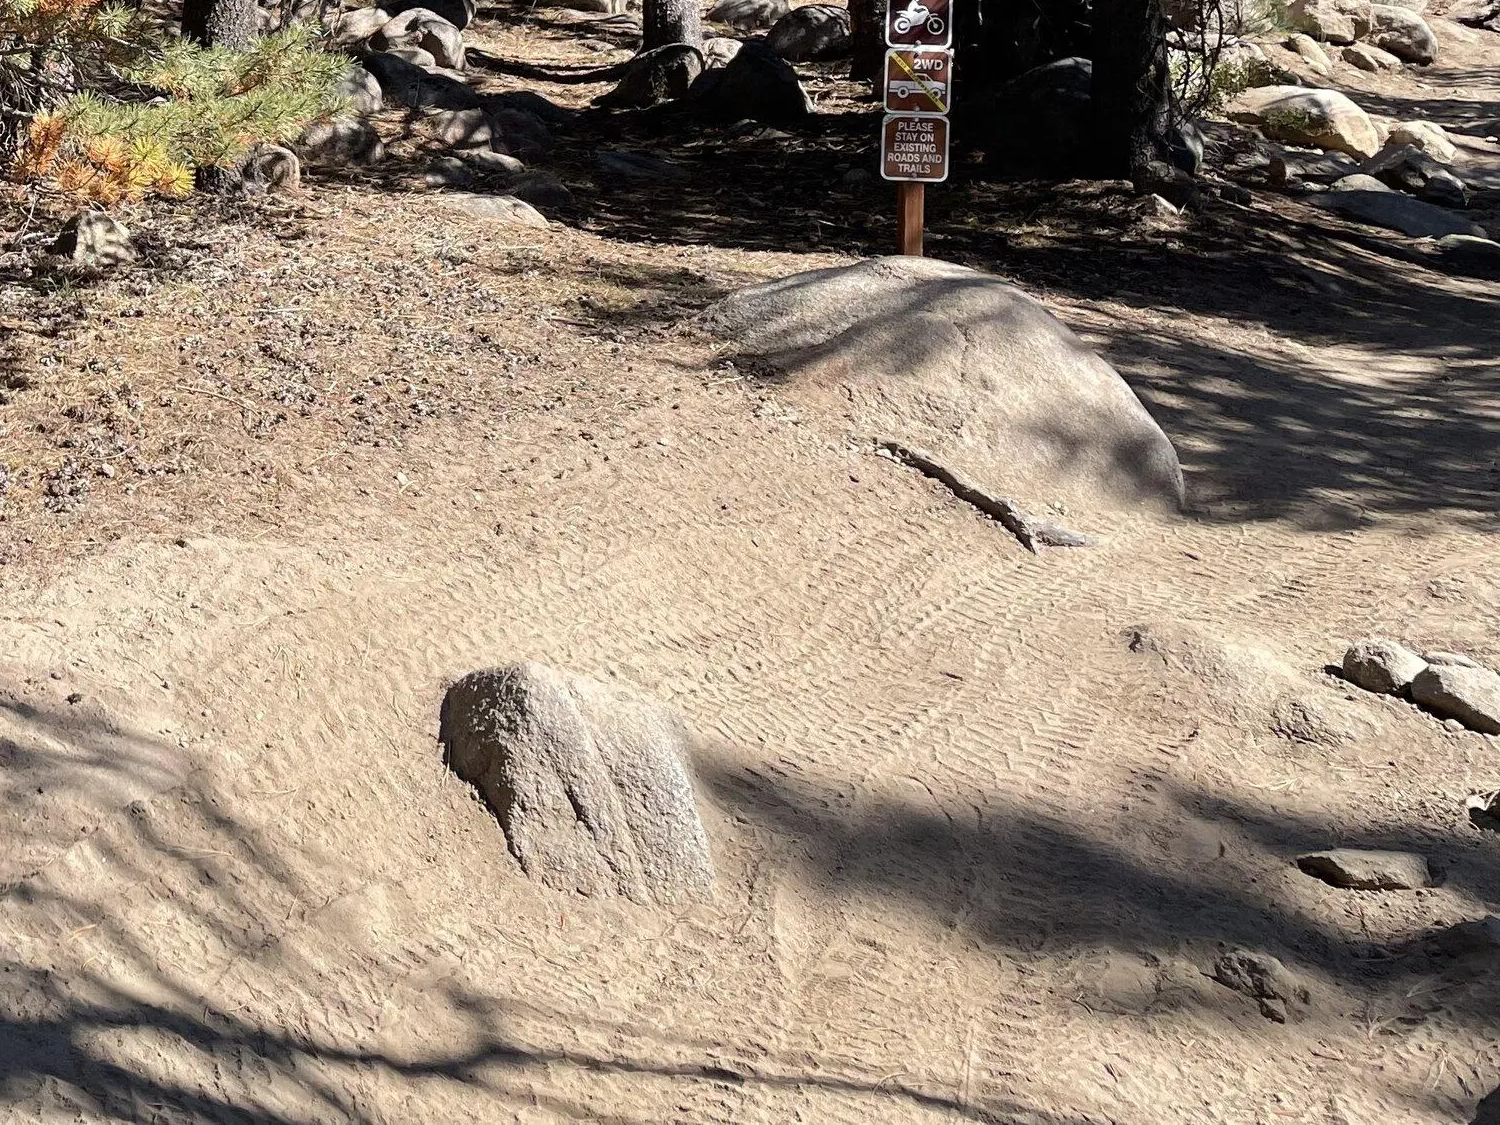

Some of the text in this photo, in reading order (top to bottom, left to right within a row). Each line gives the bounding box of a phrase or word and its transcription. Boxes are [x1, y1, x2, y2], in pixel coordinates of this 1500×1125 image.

[914, 59, 943, 70] 2WD
[898, 122, 933, 131] PLEASE
[895, 133, 934, 142] STAY ON
[894, 143, 936, 152] EXISTING
[888, 153, 942, 163] ROADS AND
[898, 164, 930, 173] TRAILS
